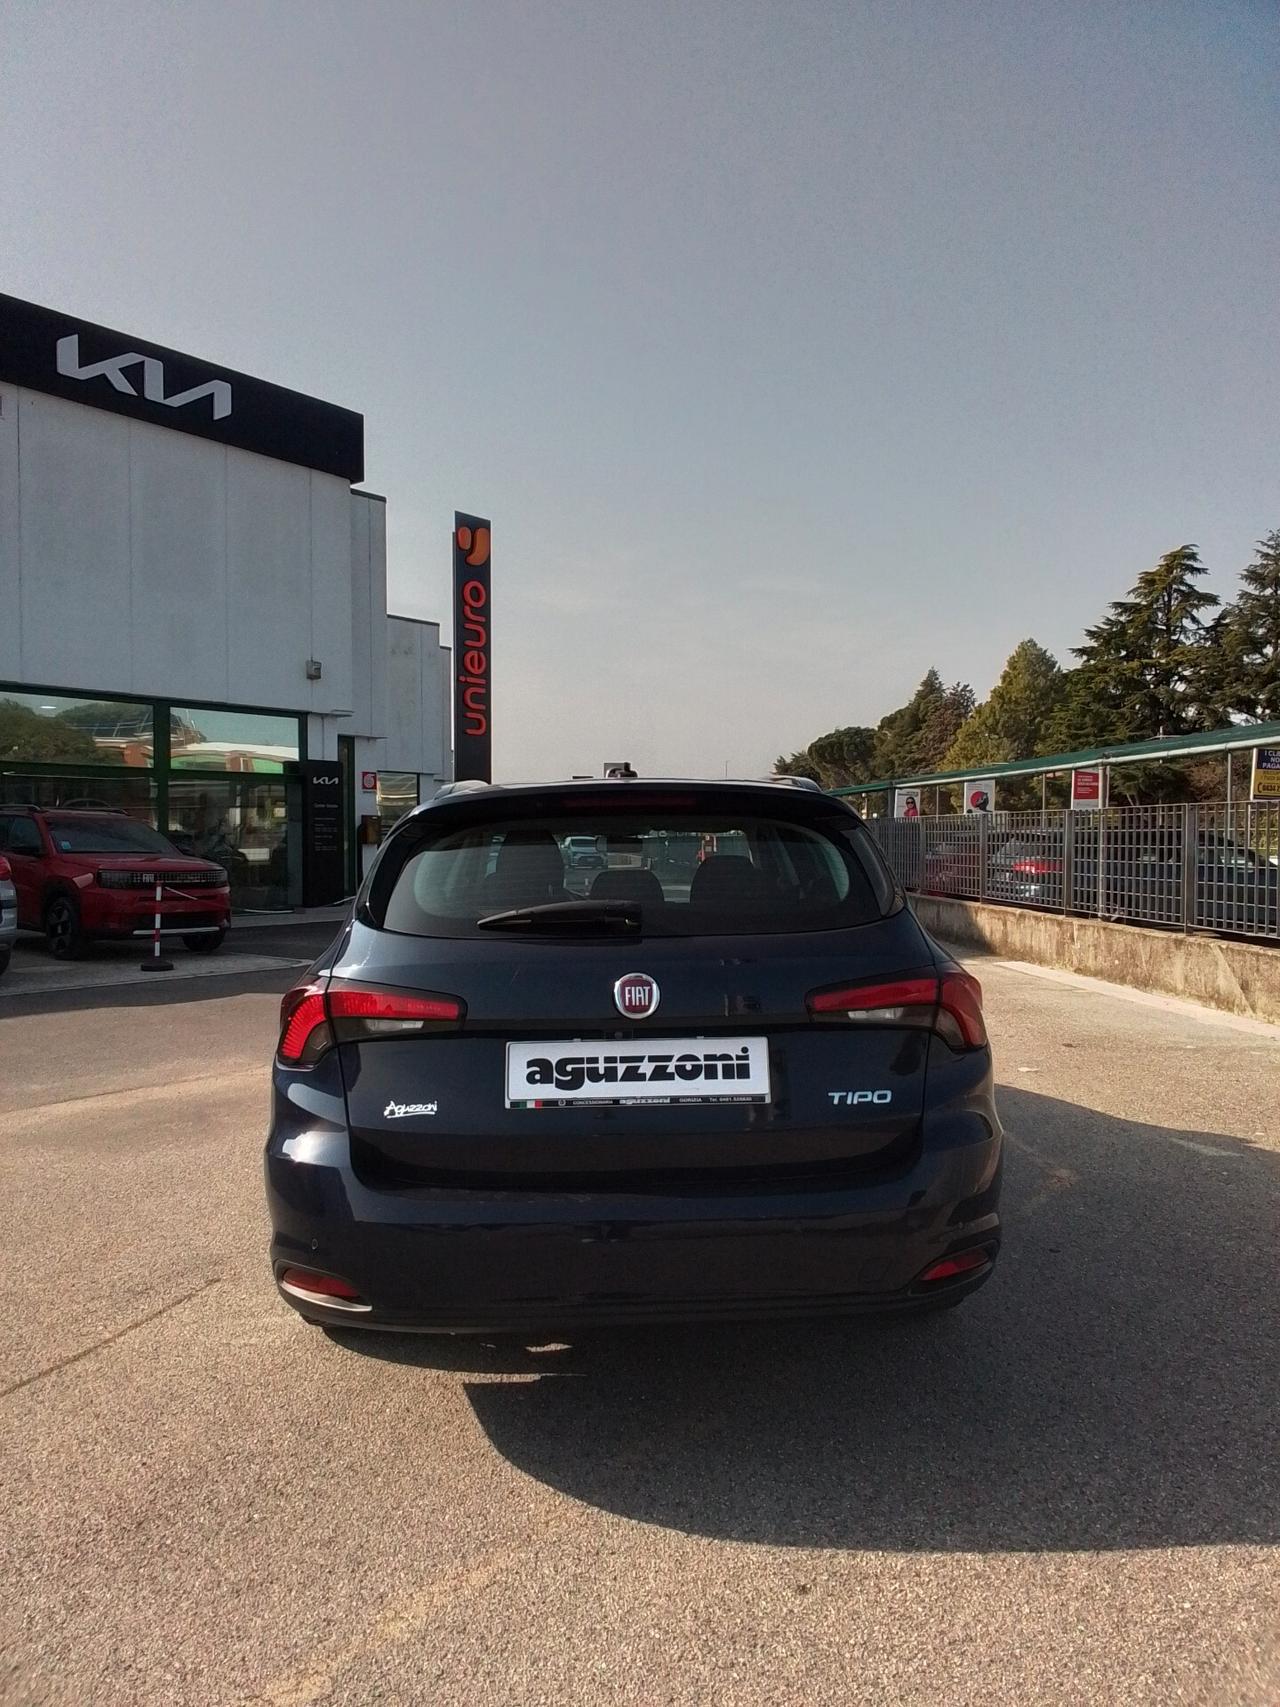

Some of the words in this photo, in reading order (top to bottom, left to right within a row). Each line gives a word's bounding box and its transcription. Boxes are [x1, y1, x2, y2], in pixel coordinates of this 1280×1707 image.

[57, 333, 232, 420] KIA
[458, 580, 487, 736] unieuro
[312, 776, 339, 785] KIA
[625, 986, 651, 1006] FIAT
[526, 1046, 751, 1091] aguzzoni
[828, 1090, 892, 1105] TIPO
